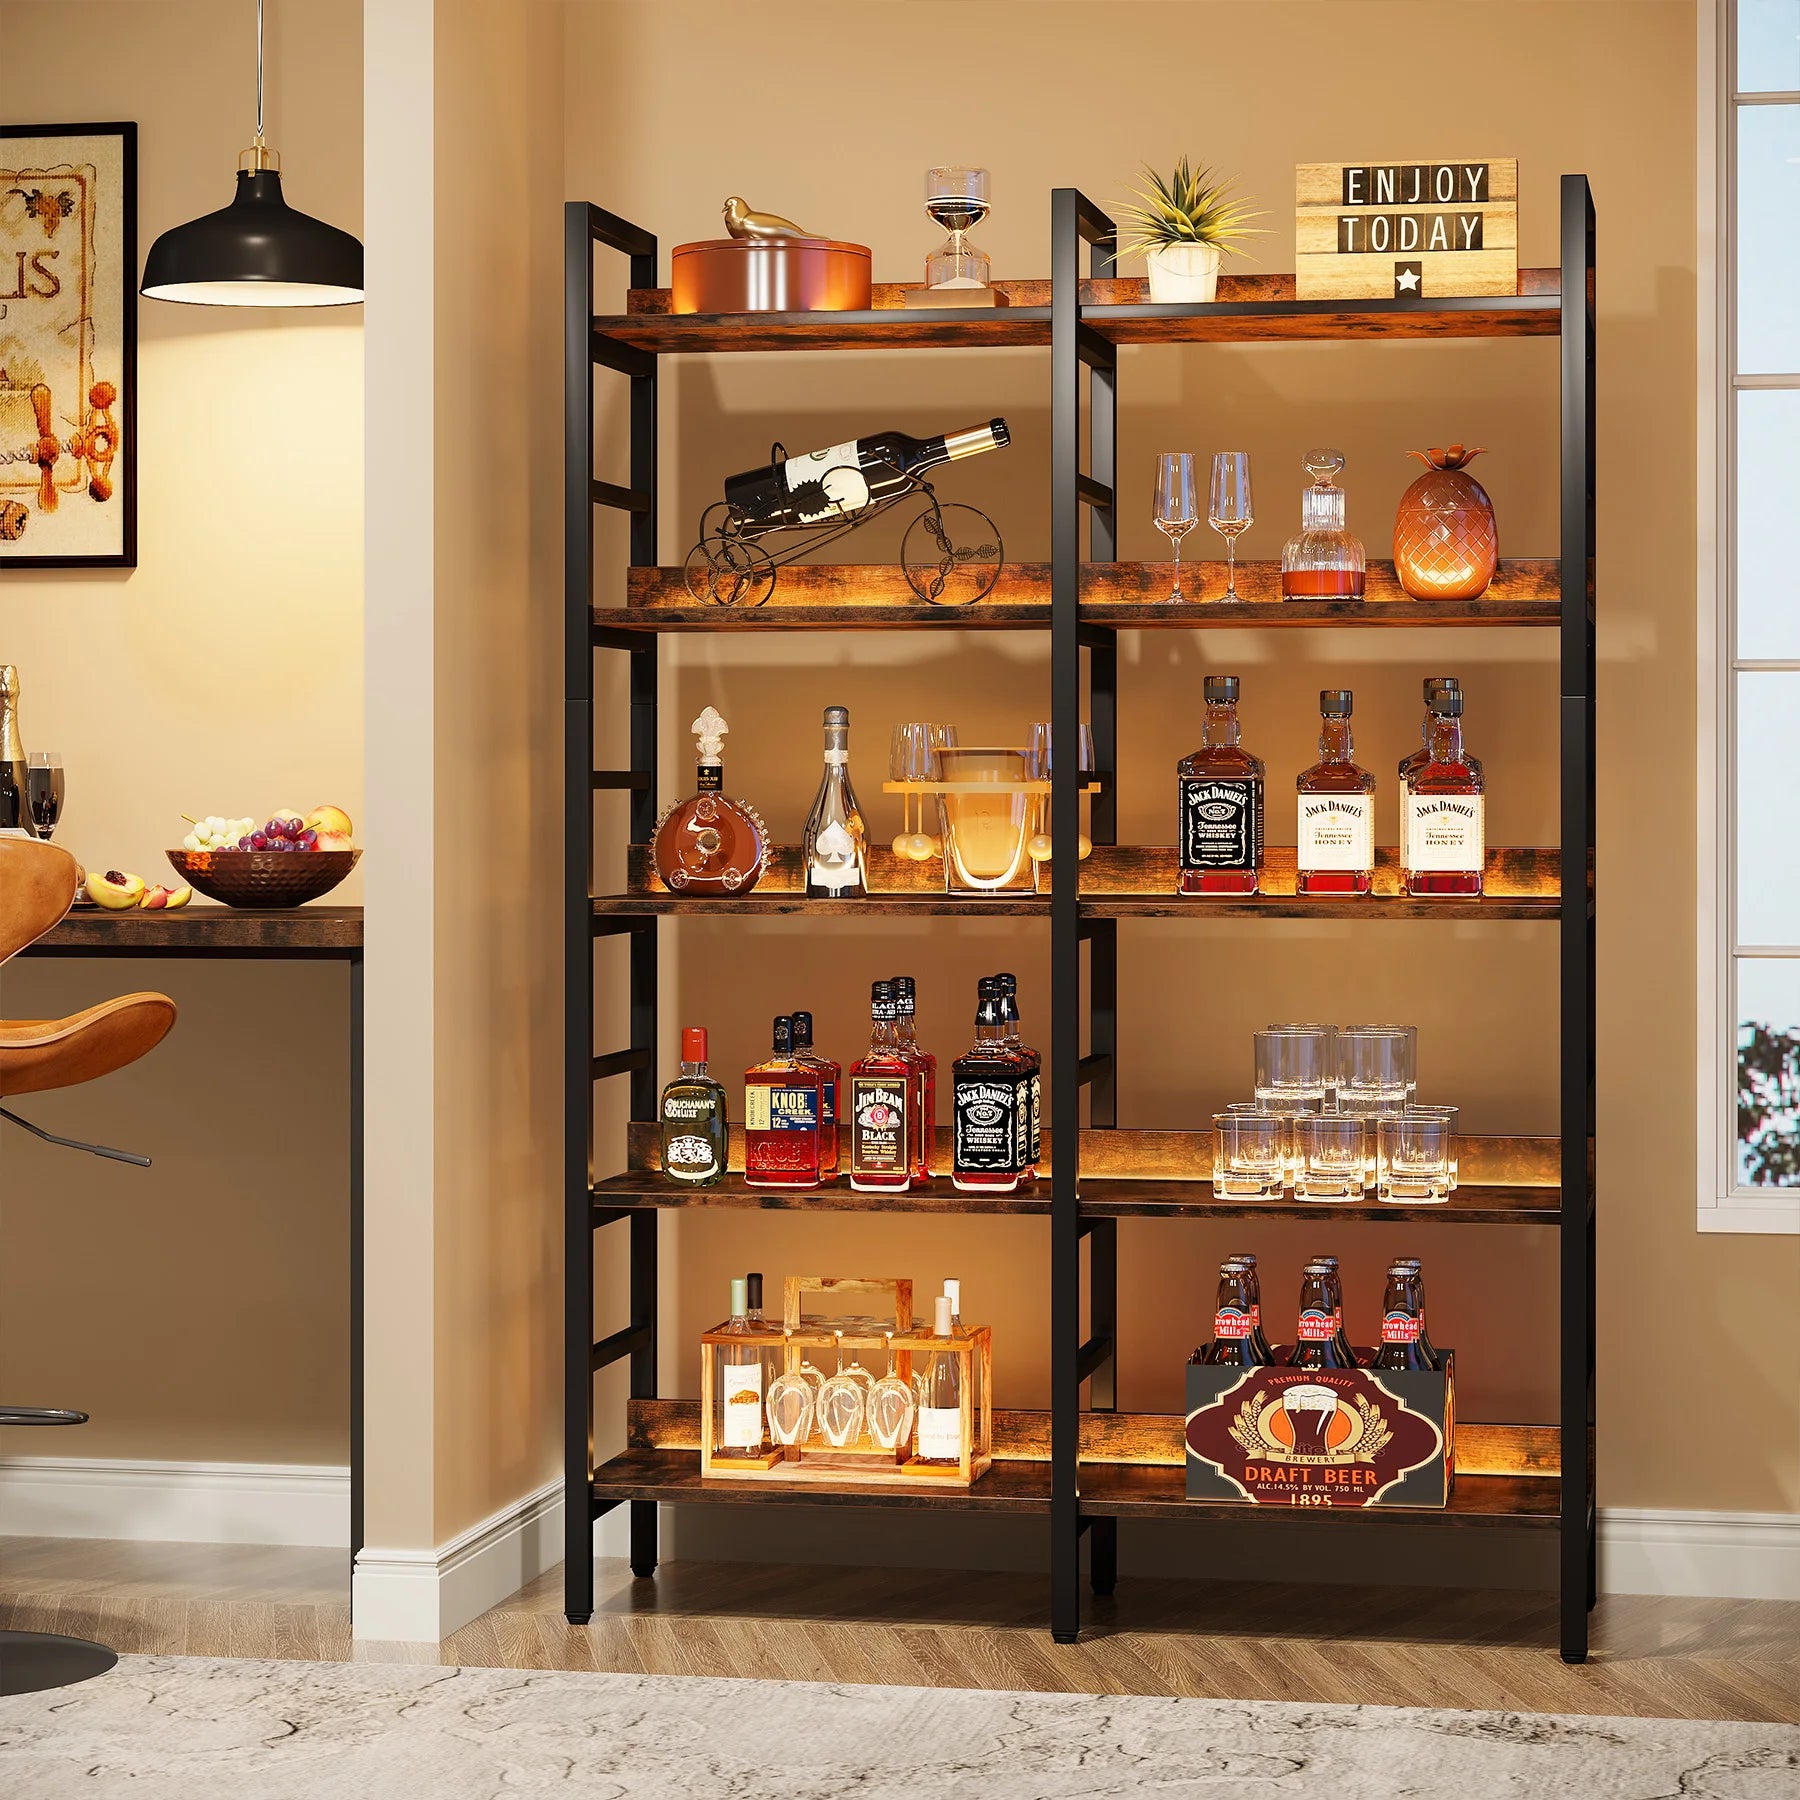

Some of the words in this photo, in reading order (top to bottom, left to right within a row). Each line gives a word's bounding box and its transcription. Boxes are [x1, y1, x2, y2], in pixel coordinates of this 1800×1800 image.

[1348, 167, 1484, 204] ENJOY
[1342, 216, 1479, 252] TODAY
[0, 251, 60, 298] IS
[1188, 789, 1211, 806] JACK
[1211, 786, 1248, 806] DANIEL'S
[1306, 803, 1327, 818] JACK
[1328, 800, 1364, 818] DANIEL'S
[1416, 803, 1438, 818] JACK
[1439, 800, 1476, 818] DANIEL'S
[1197, 821, 1237, 830] Tennessee
[1425, 831, 1464, 839] Tennessee
[772, 1092, 805, 1109] KNOB
[855, 1091, 875, 1113] JIM
[875, 1088, 903, 1114] BEAM
[957, 1088, 979, 1107] JACK
[979, 1085, 1015, 1108] DANIEL'S
[673, 1099, 716, 1110] BUCHANAN'S
[672, 1109, 698, 1118] DELUXE
[772, 1117, 781, 1128] 12
[965, 1124, 1004, 1134] Tennessee
[862, 1129, 897, 1141] BLACK
[1215, 1318, 1250, 1326] rrowhead
[1299, 1319, 1333, 1328] rrowhead
[1382, 1321, 1418, 1330] rrowhead
[1219, 1326, 1241, 1335] Mills
[1302, 1328, 1325, 1337] Mills
[1386, 1331, 1409, 1340] Mills
[1268, 1375, 1310, 1386] PREMIUM
[1315, 1375, 1356, 1388] QUALITY
[1285, 1455, 1336, 1463] BREWERY
[1245, 1466, 1312, 1482] DRAFT
[1324, 1469, 1378, 1485] BEER
[1290, 1493, 1333, 1506] 1895
